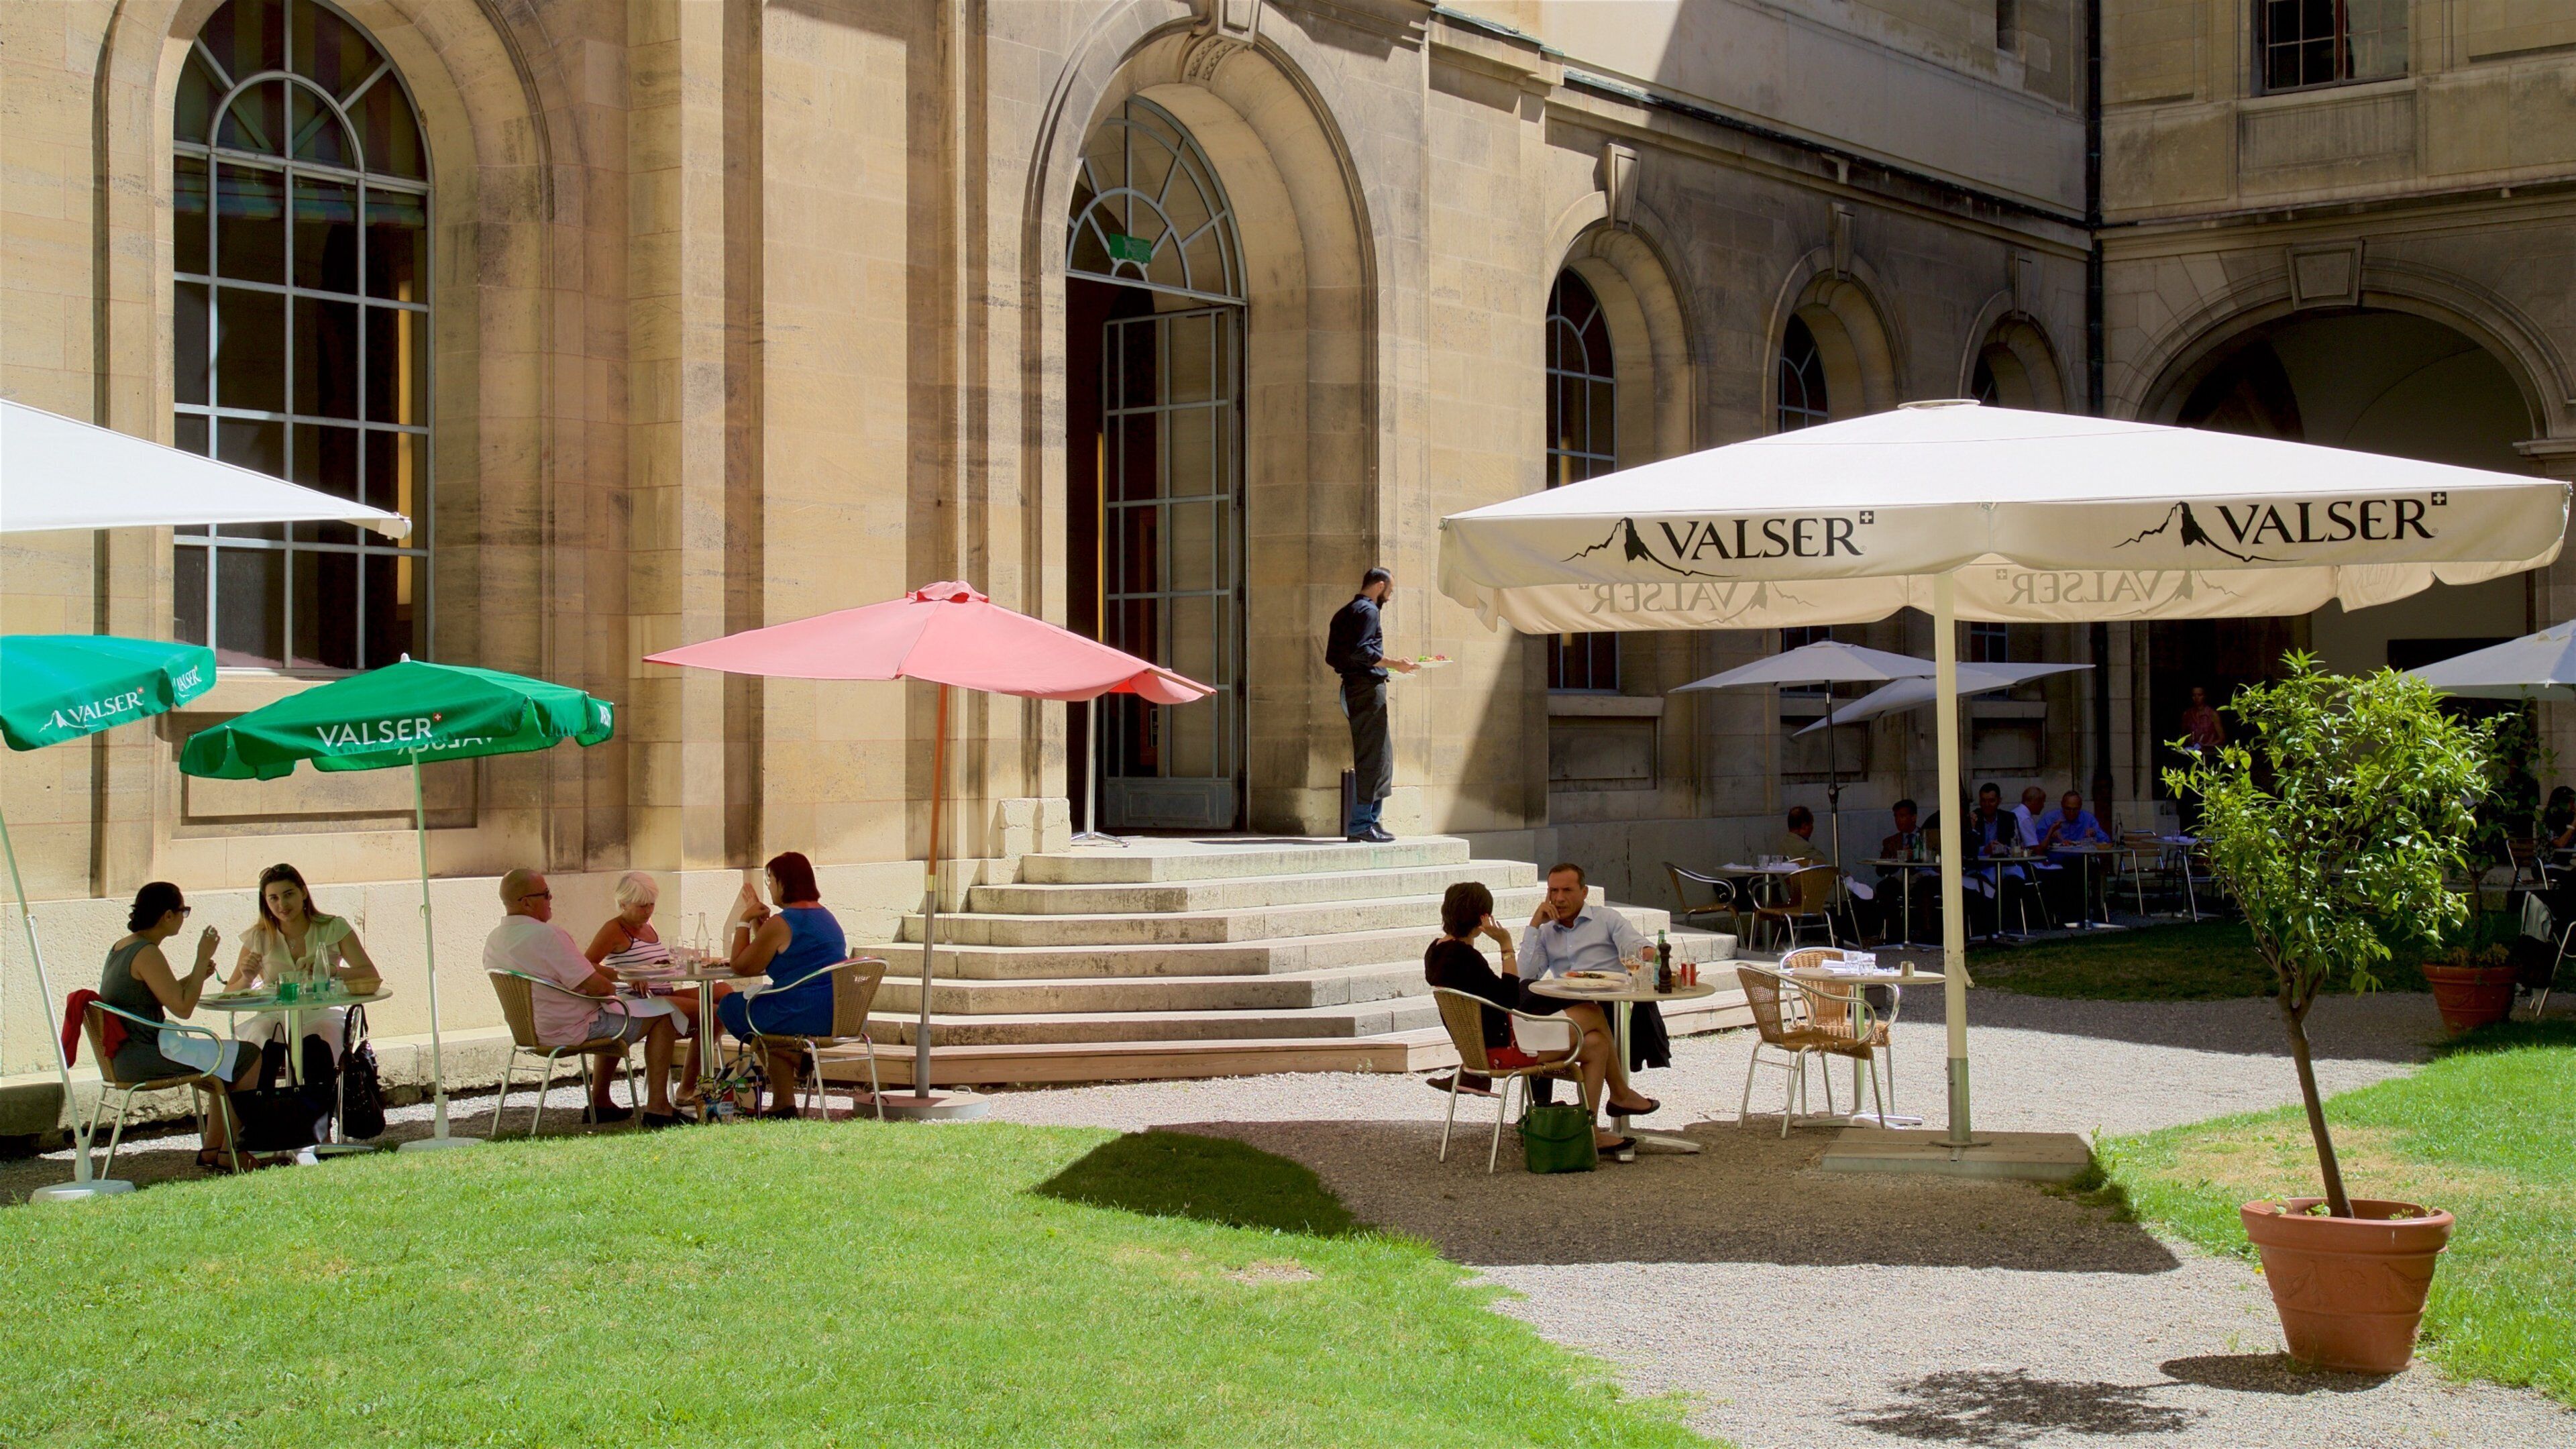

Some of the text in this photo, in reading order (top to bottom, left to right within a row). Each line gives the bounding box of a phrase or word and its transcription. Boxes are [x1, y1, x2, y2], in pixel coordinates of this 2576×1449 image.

[1657, 517, 1864, 559] VALSER
[2214, 498, 2436, 544] VALSER
[68, 692, 144, 722] VALSER
[316, 718, 433, 747] VALSER
